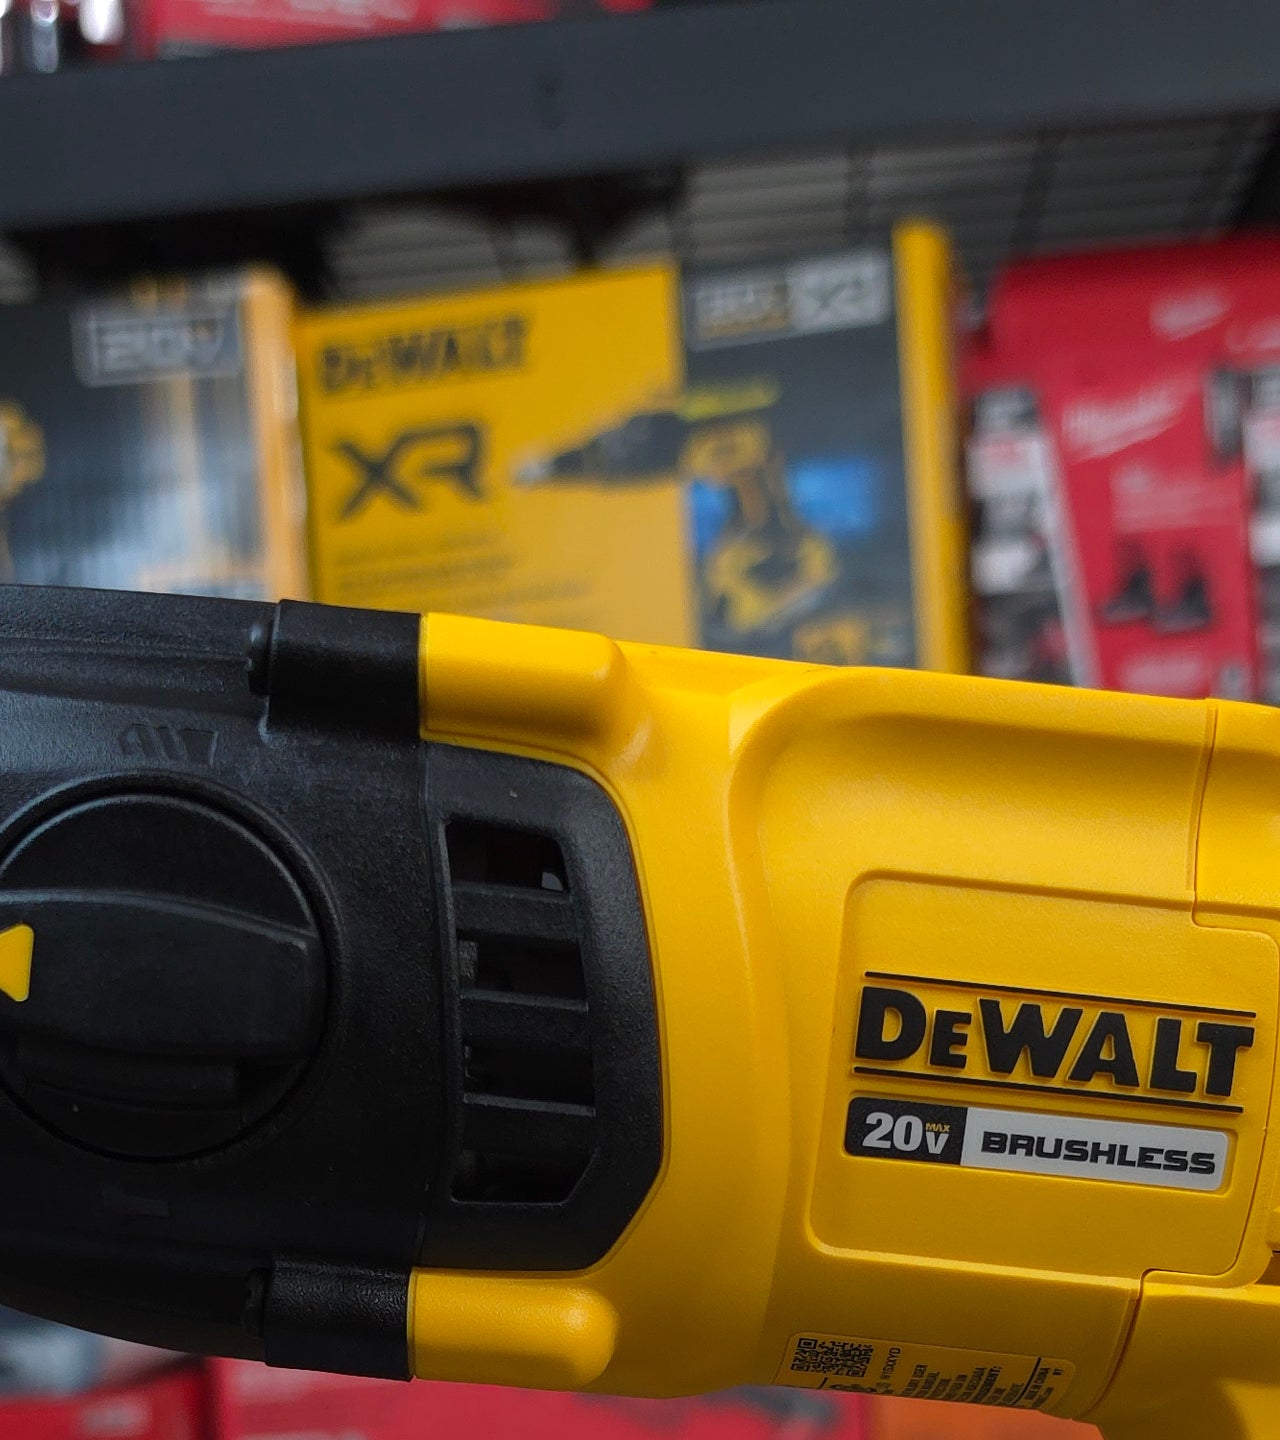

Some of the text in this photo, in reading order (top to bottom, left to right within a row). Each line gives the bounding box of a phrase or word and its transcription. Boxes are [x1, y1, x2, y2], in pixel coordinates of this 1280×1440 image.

[332, 419, 490, 520] XR
[925, 1122, 951, 1133] MAX
[981, 1131, 1216, 1175] BRUSHLESS
